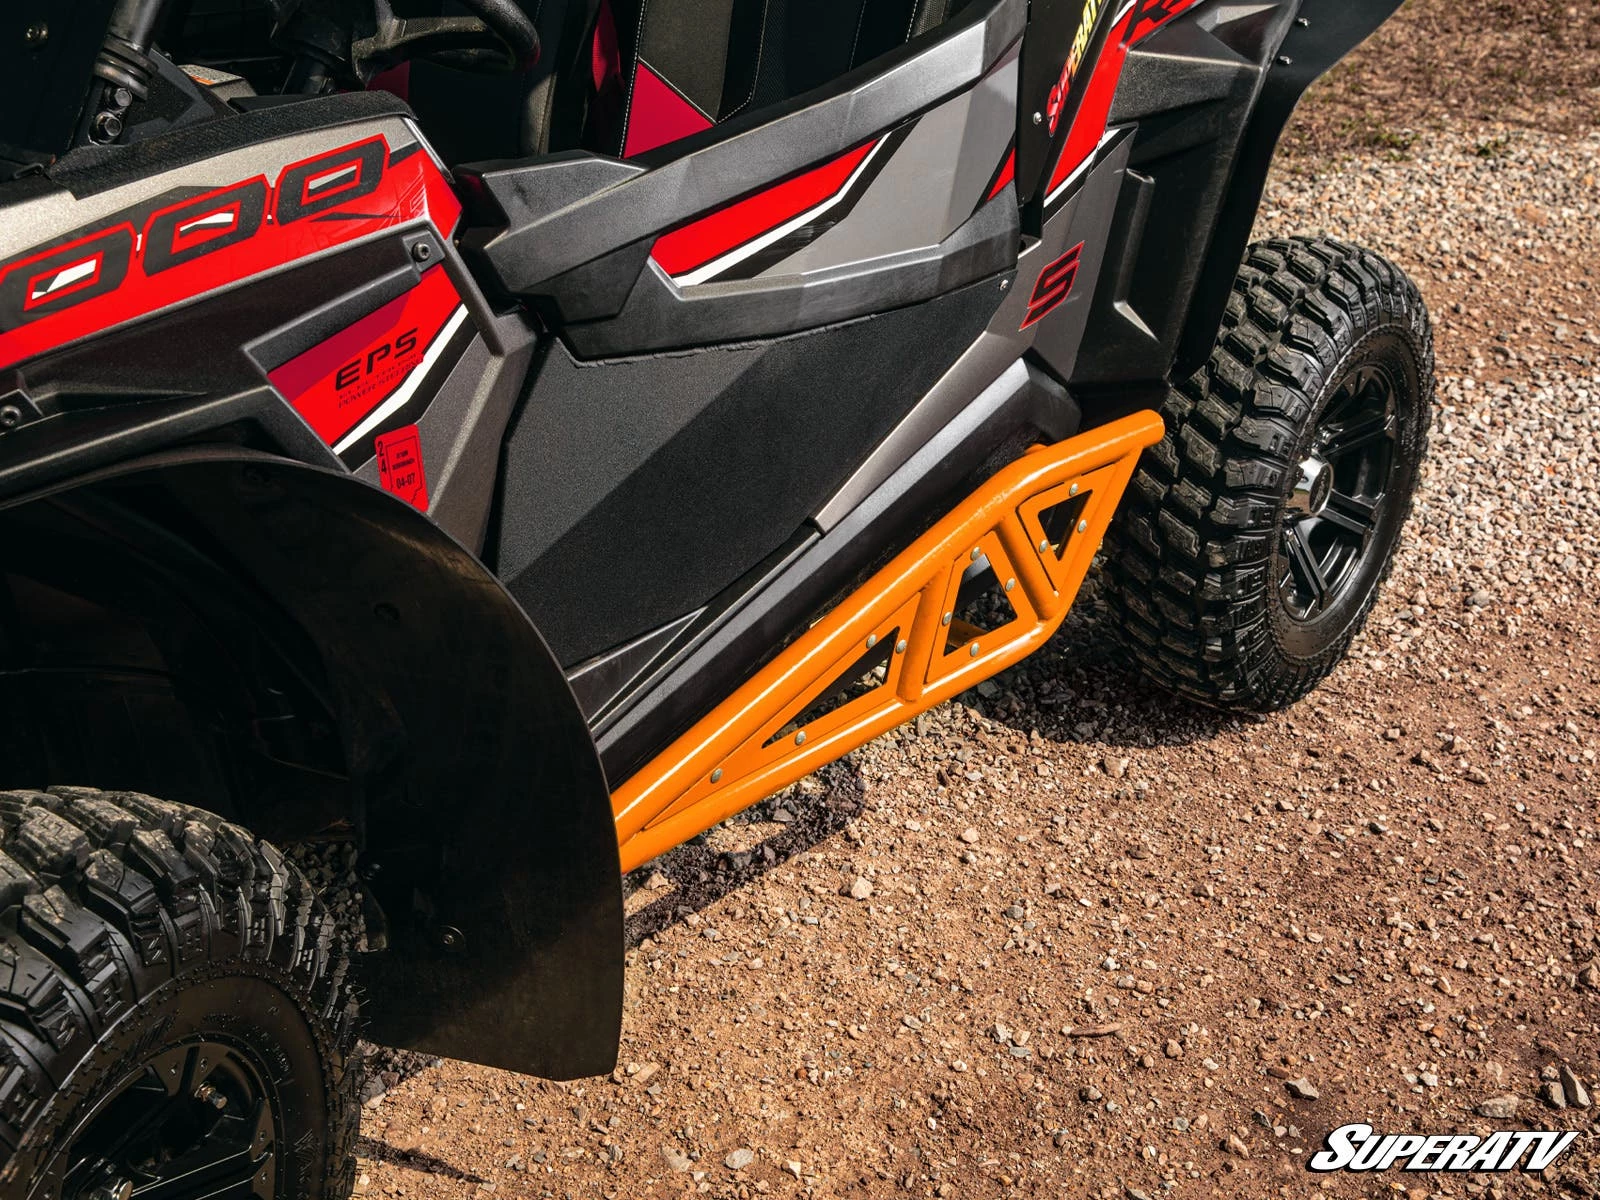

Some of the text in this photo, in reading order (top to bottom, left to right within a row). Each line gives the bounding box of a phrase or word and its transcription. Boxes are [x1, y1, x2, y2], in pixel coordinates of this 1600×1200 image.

[1046, 0, 1103, 137] SUPERAT
[1018, 240, 1085, 331] S
[335, 327, 418, 391] EPS
